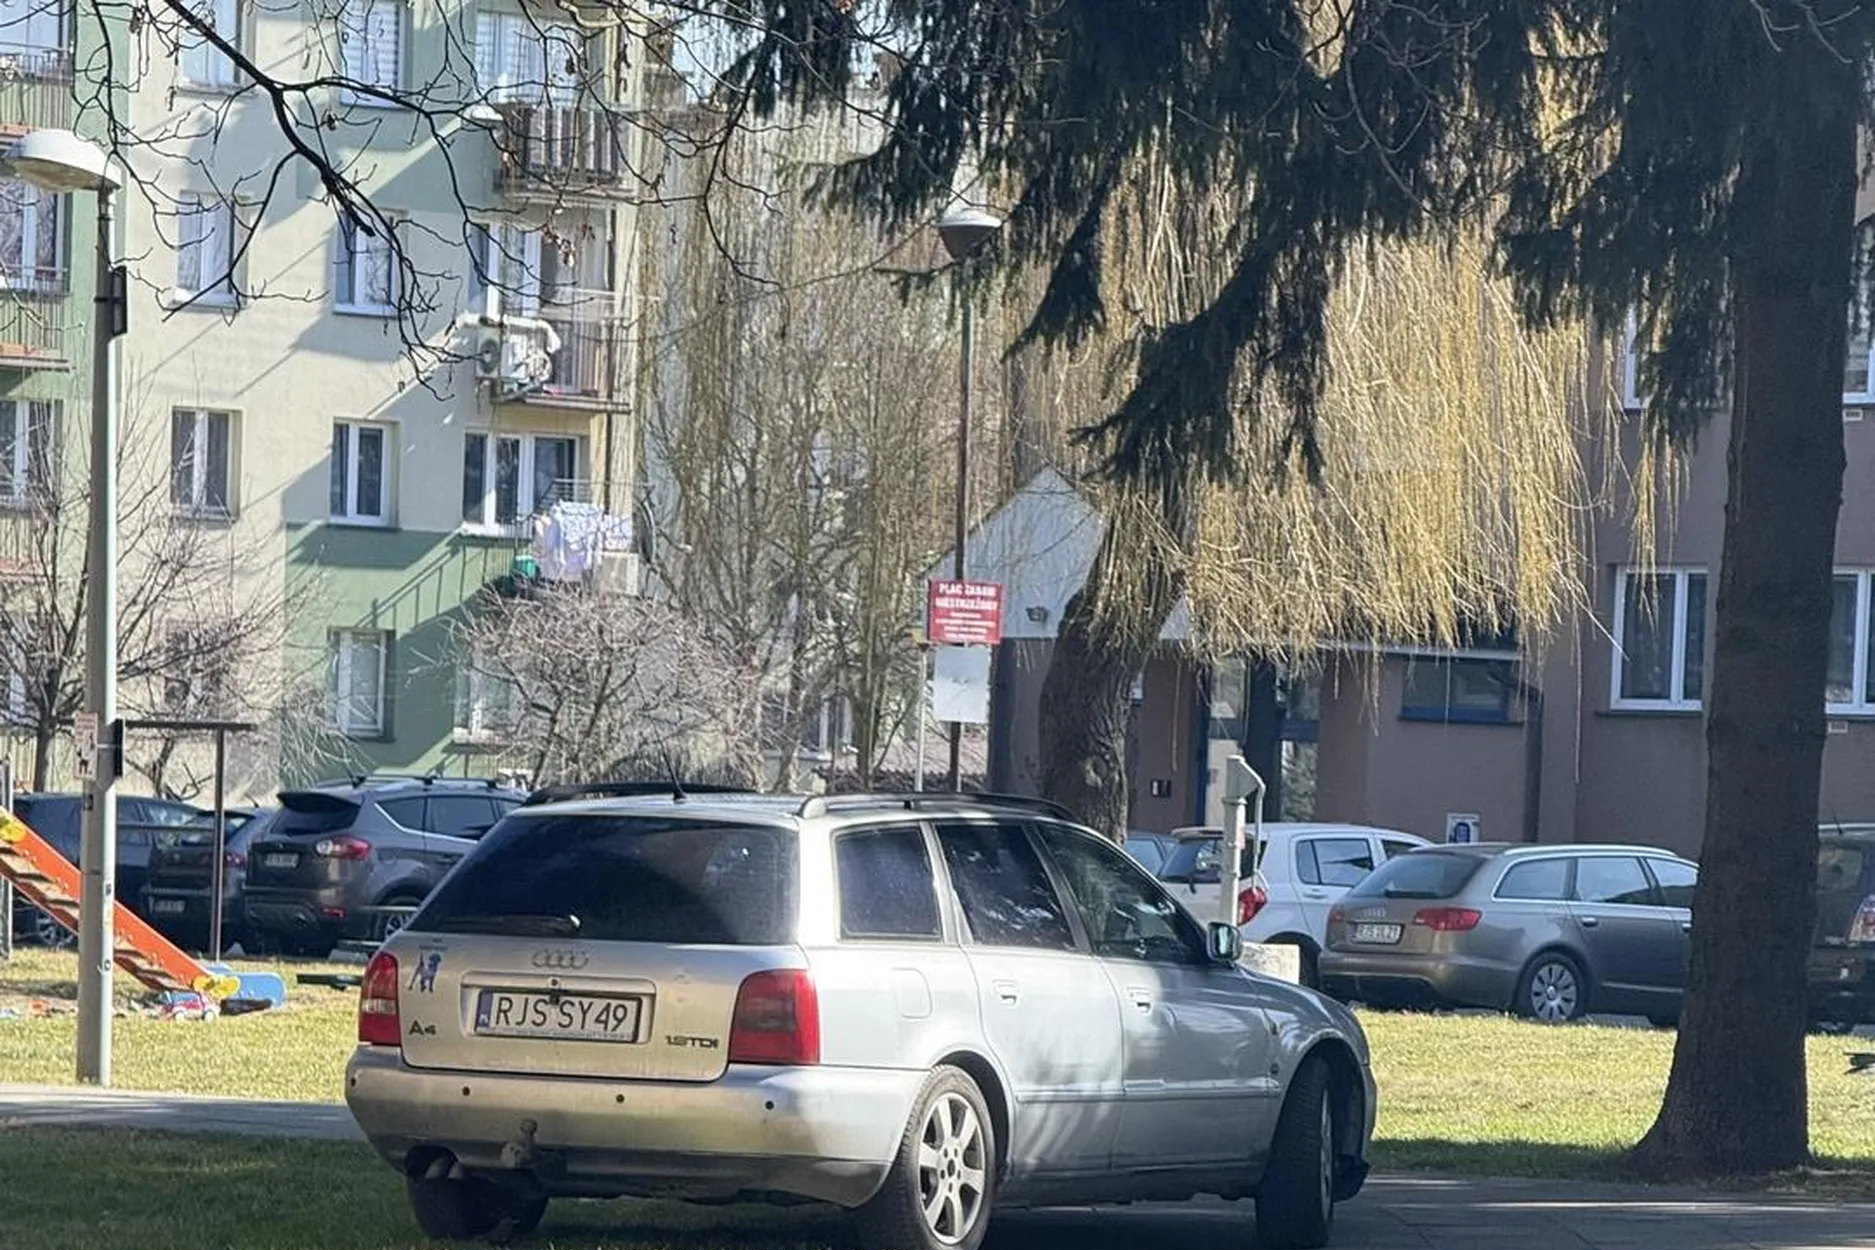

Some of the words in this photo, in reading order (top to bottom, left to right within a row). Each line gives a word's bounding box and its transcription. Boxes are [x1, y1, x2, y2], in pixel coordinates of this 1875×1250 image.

[939, 583, 963, 595] PLAC
[495, 996, 548, 1027] RJS
[557, 1000, 628, 1032] SY49
